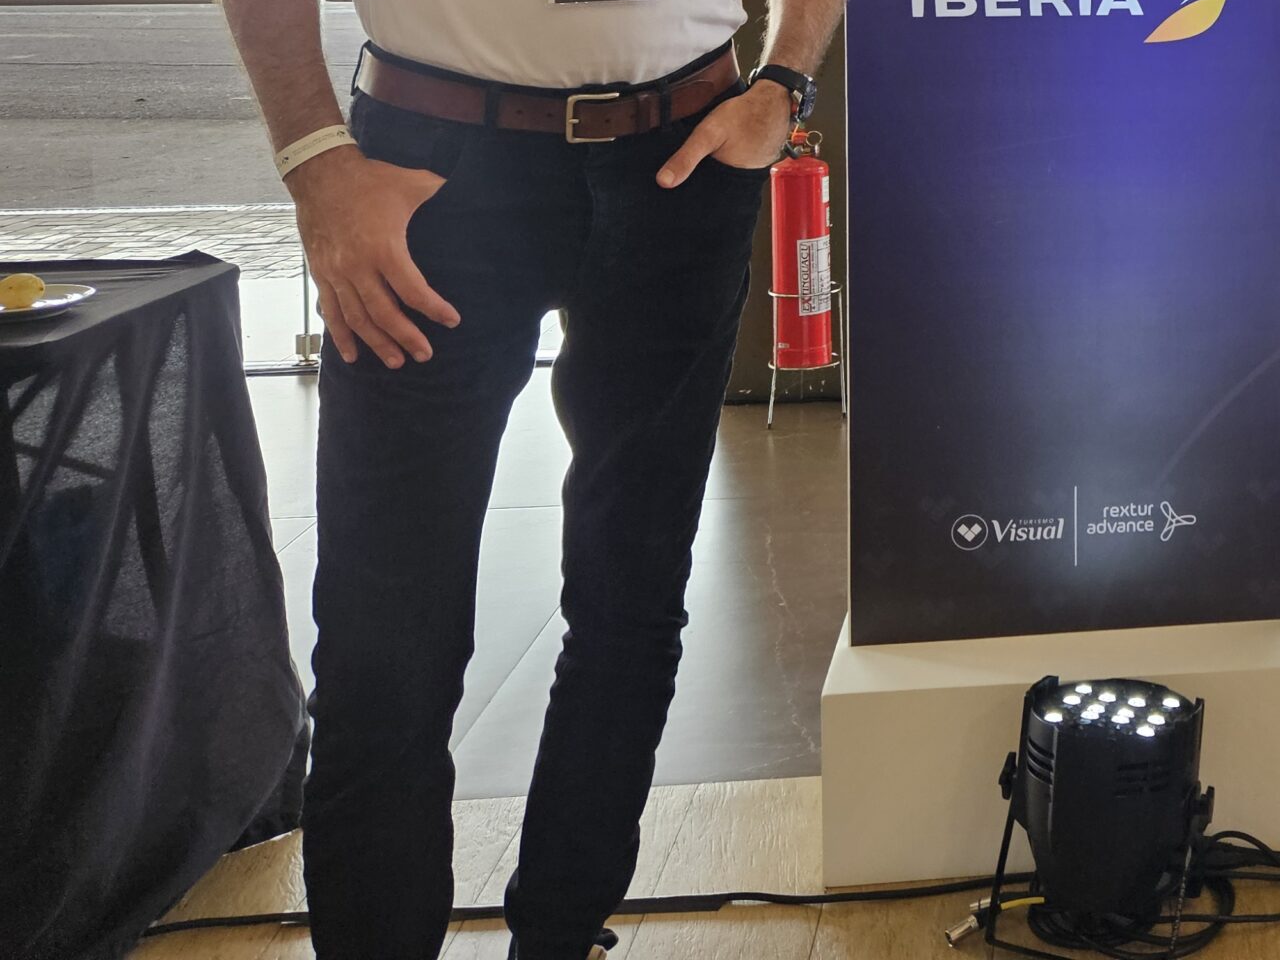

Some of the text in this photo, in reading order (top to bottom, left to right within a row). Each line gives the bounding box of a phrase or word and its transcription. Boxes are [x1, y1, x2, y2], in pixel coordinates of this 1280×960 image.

[1103, 502, 1154, 518] rextur
[991, 518, 1065, 543] Visual
[1086, 519, 1154, 535] advance
